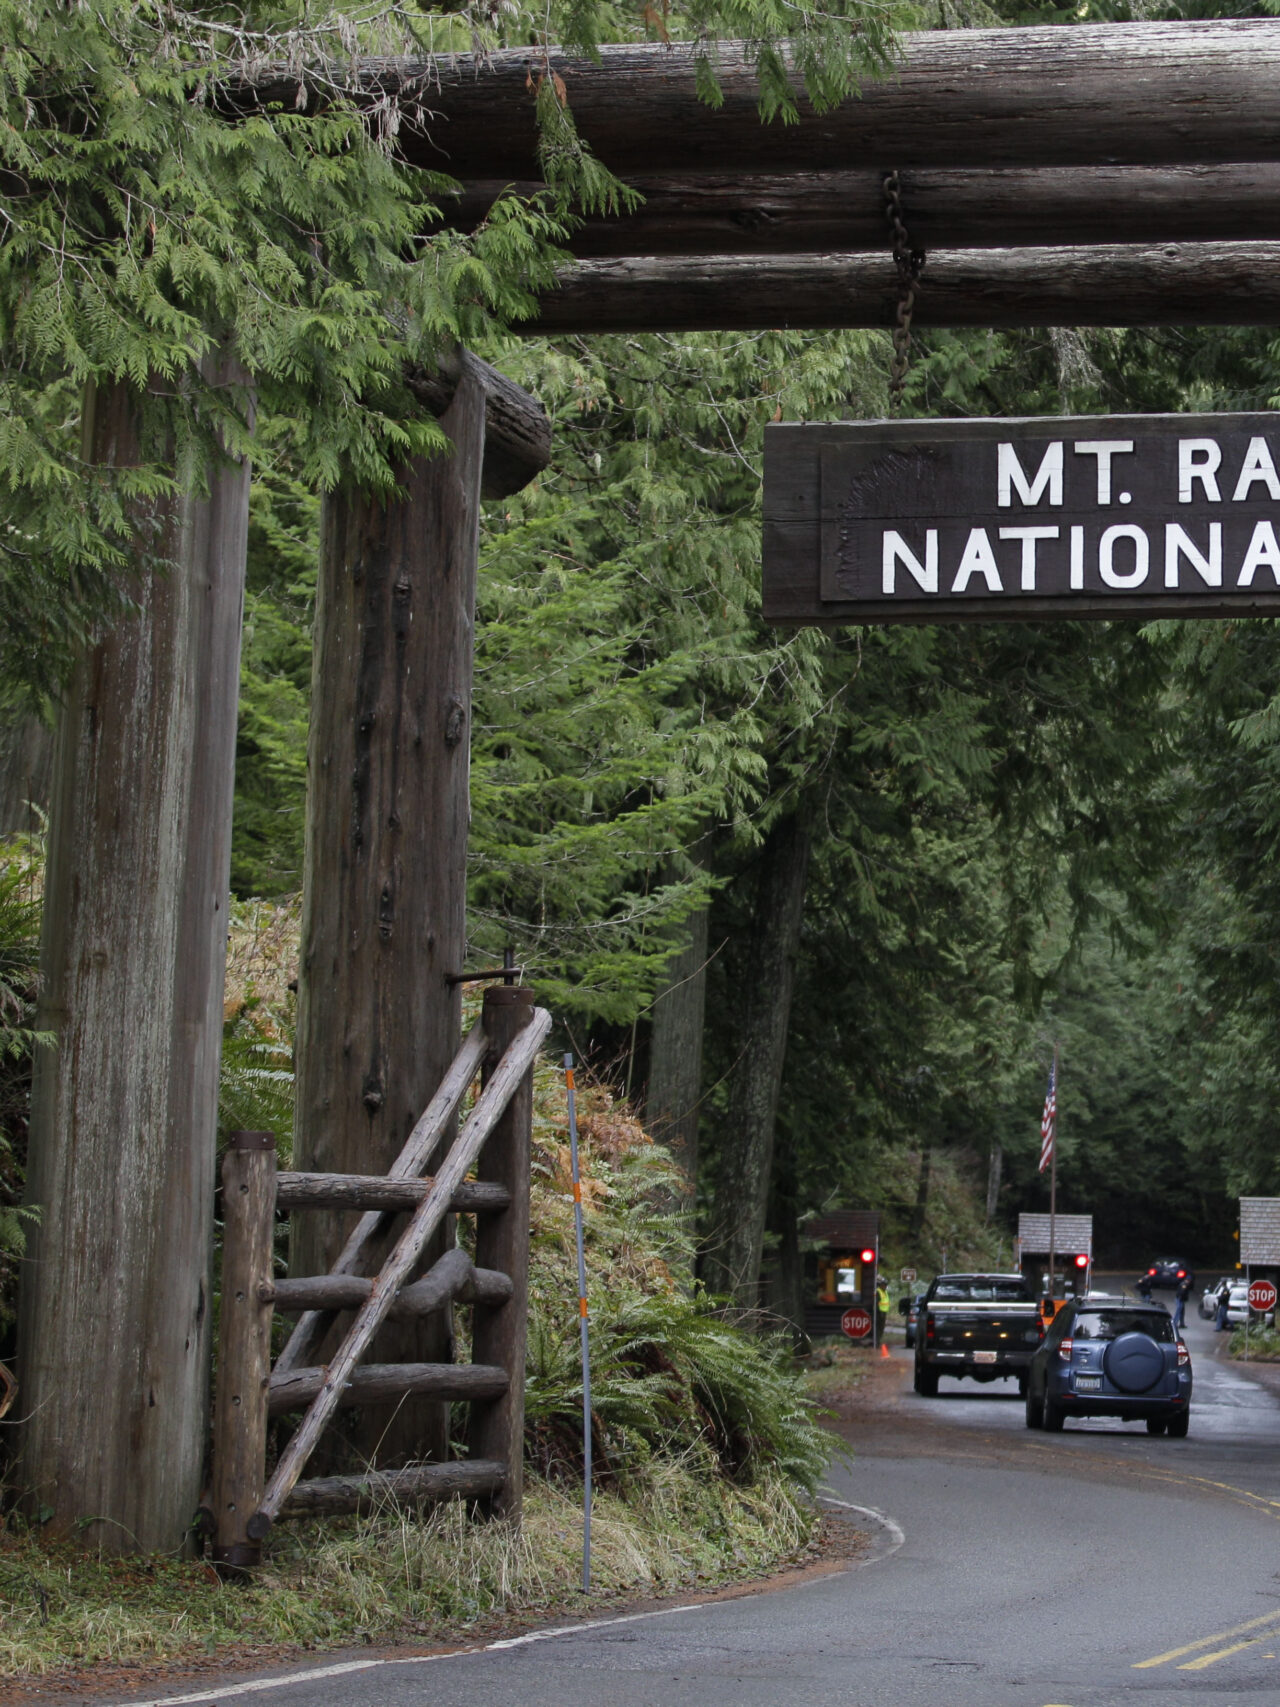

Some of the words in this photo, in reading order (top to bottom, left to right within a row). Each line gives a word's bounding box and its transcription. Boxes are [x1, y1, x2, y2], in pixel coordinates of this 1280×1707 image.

[998, 440, 1134, 507] MT.
[1249, 1289, 1275, 1302] STOP
[844, 1316, 869, 1329] STOP
